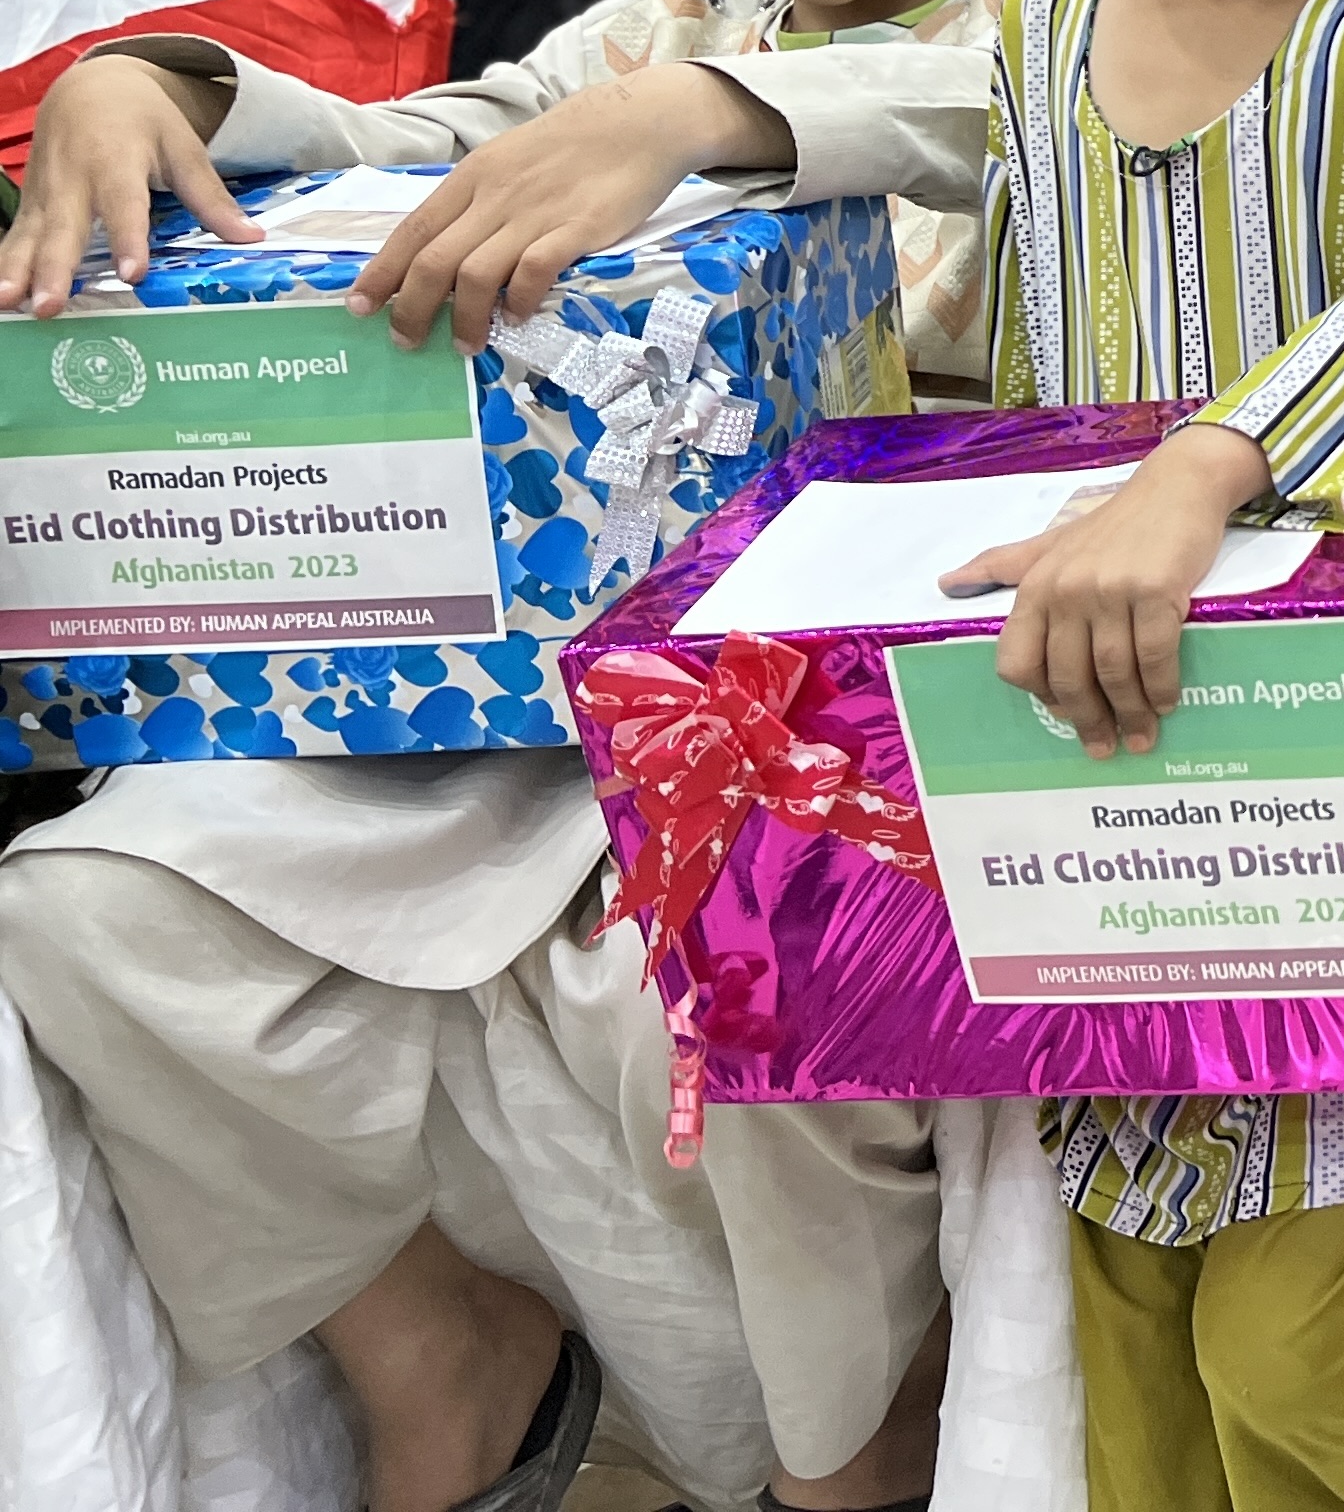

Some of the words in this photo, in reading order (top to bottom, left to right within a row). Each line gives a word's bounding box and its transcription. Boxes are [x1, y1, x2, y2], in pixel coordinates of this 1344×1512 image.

[155, 359, 250, 383] Human
[256, 349, 350, 381] Appeal
[174, 428, 252, 446] hai.org.au
[107, 466, 226, 491] Ramadan
[232, 463, 329, 492] Projects
[4, 513, 63, 545] Eid
[71, 508, 224, 546] Clothing
[229, 501, 448, 538] Distribution
[110, 556, 275, 589] Afghanistan
[287, 553, 360, 579] 2023
[49, 615, 167, 637] IMPLEMENTED
[168, 614, 197, 634] BY:
[200, 612, 270, 633] HUMAN
[271, 610, 338, 630] APPEAL
[339, 607, 435, 629] AUSTRALIA
[1164, 759, 1249, 778] hai.org.au
[1091, 800, 1222, 830] Ramadan
[1229, 797, 1336, 828] Projects
[981, 853, 1044, 888] Eid
[1052, 849, 1222, 888] Clothing
[1098, 898, 1280, 936] Afghanistan
[1036, 961, 1164, 985] IMPLEMENTED
[1164, 960, 1197, 982] BY:
[1200, 958, 1276, 981] HUMAN
